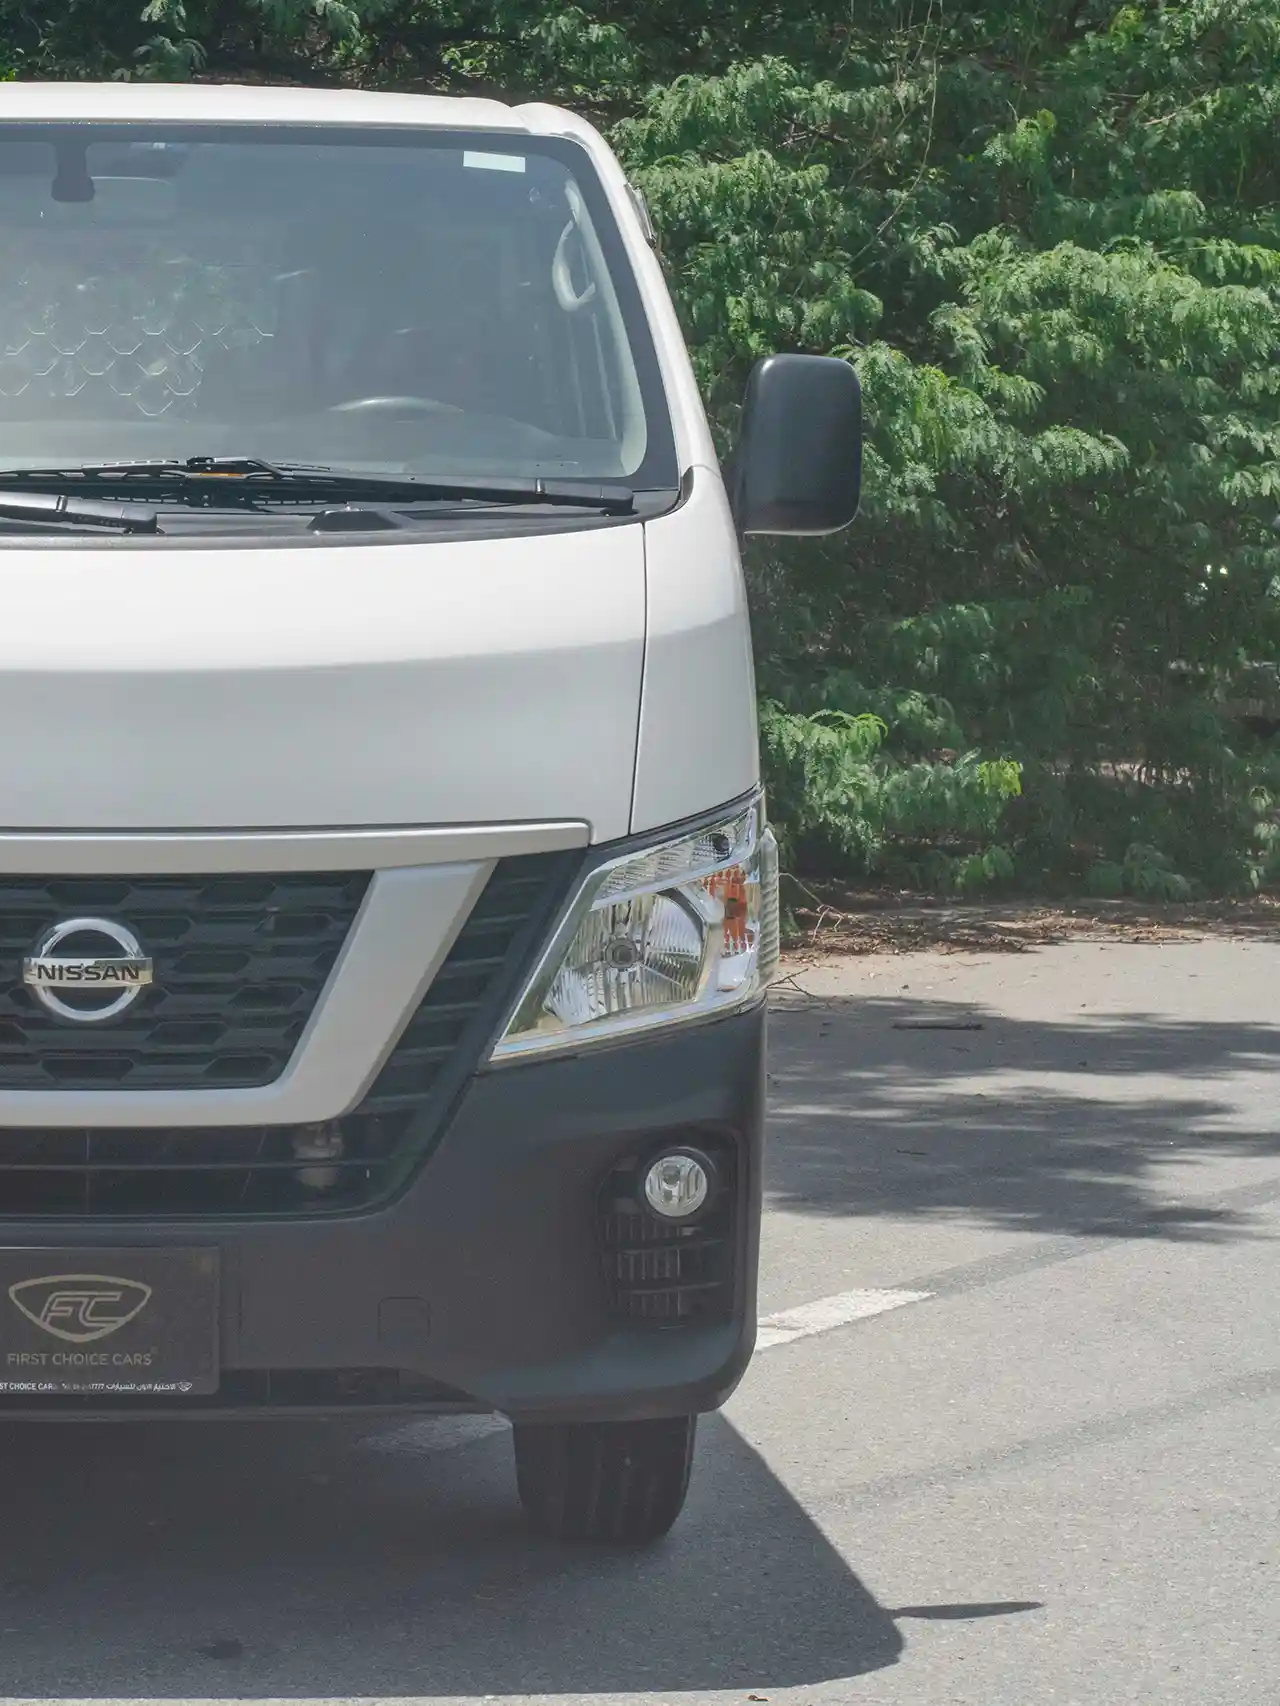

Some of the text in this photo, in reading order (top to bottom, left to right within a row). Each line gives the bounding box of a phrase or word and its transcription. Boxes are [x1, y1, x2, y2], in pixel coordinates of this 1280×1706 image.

[37, 964, 140, 981] NISSAN
[6, 1353, 152, 1366] FIRST CHOICE CARS
[9, 1381, 37, 1391] CHOICE
